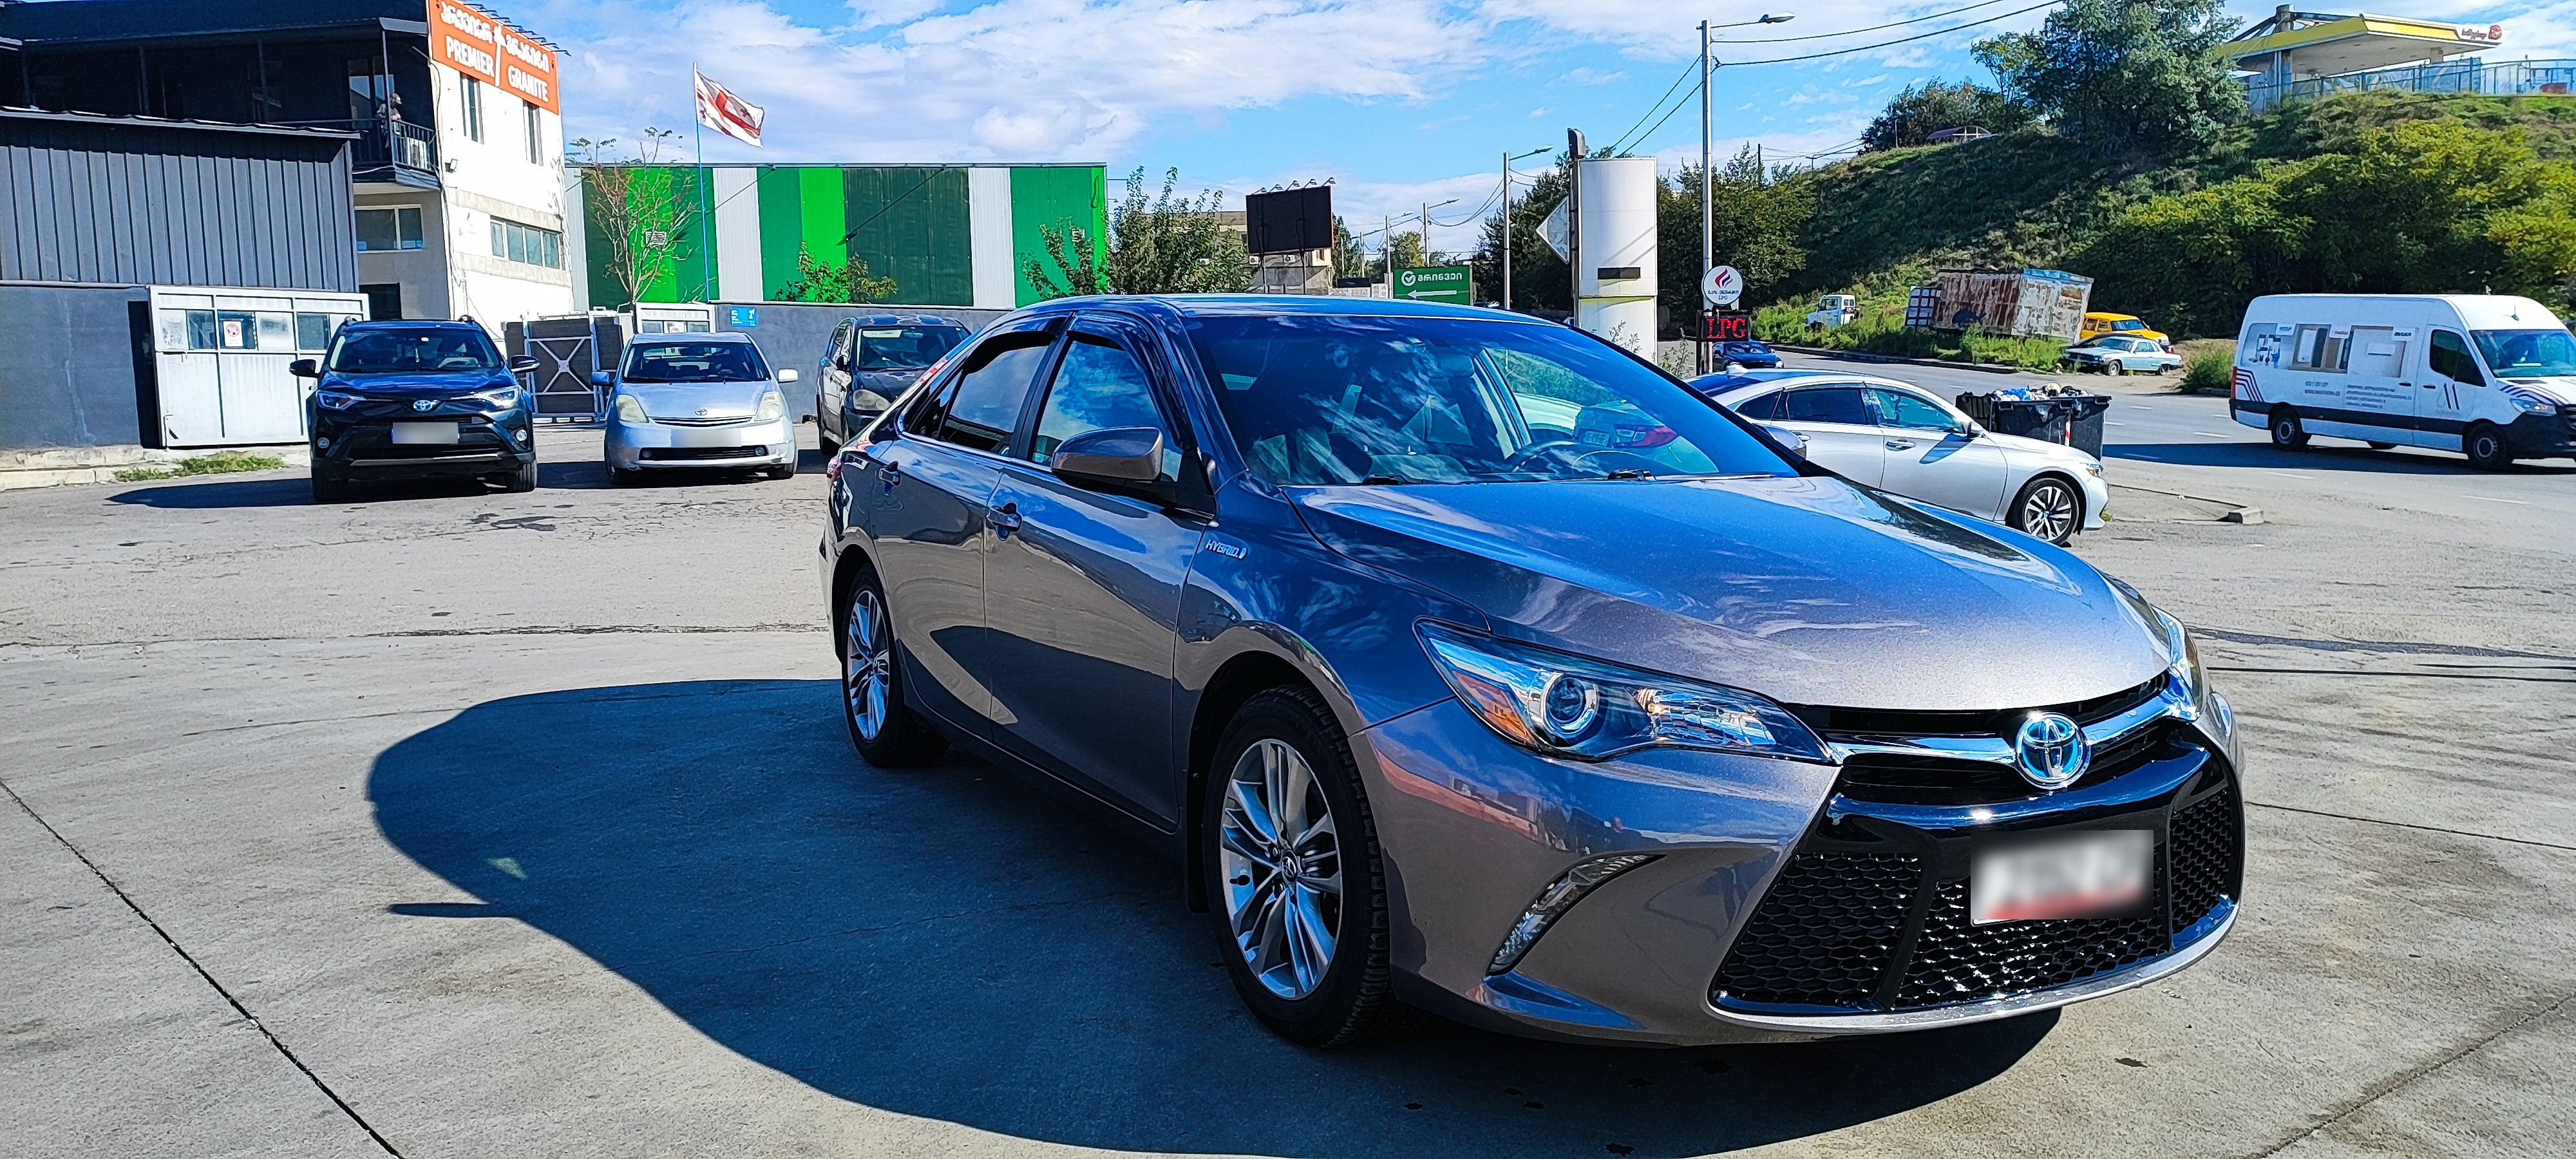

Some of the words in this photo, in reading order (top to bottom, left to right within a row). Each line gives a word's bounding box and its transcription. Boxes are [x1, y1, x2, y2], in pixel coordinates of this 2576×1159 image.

[446, 35, 495, 77] PREMIER
[508, 65, 549, 102] GRANITE
[1707, 317, 1745, 338] LPG
[1205, 539, 1239, 558] HYBRID
